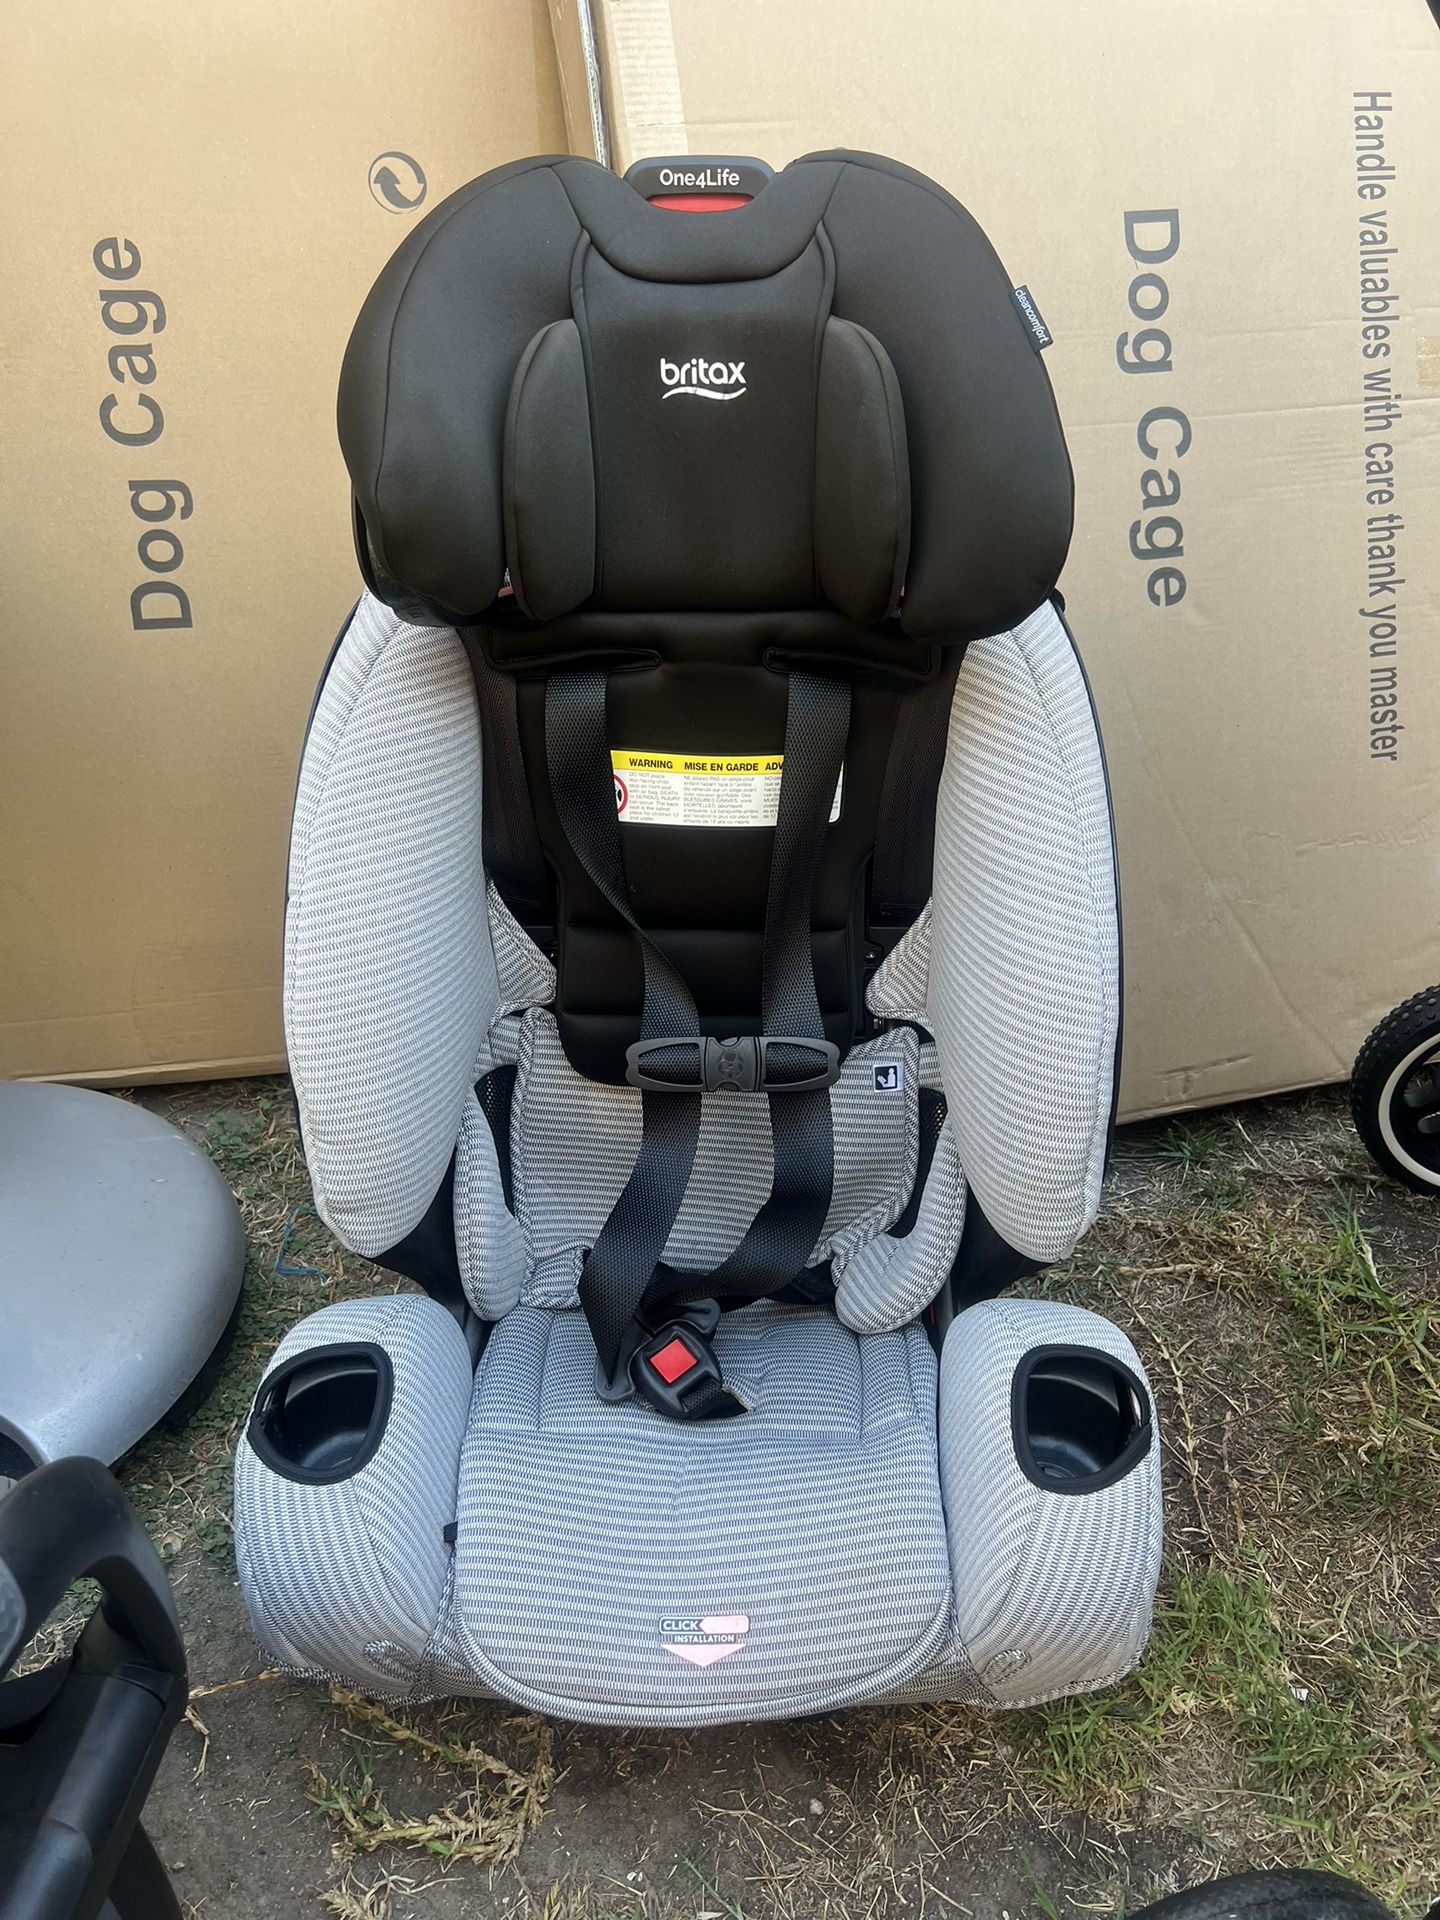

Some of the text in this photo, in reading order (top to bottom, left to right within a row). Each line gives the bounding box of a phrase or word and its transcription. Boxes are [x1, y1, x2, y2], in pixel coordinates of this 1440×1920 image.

[659, 168, 741, 189] One4Life
[1014, 289, 1050, 344] cleancomfort
[660, 358, 747, 386] britax
[1116, 208, 1192, 607] Dog Cage
[92, 237, 194, 631] Dog Cage
[1353, 92, 1406, 762] Handle valuables with care thank you master
[629, 758, 673, 770] WARNING
[684, 762, 758, 772] MISE EN GARDE
[662, 1620, 698, 1630] CLICK
[674, 1634, 735, 1643] INSTALLATION
